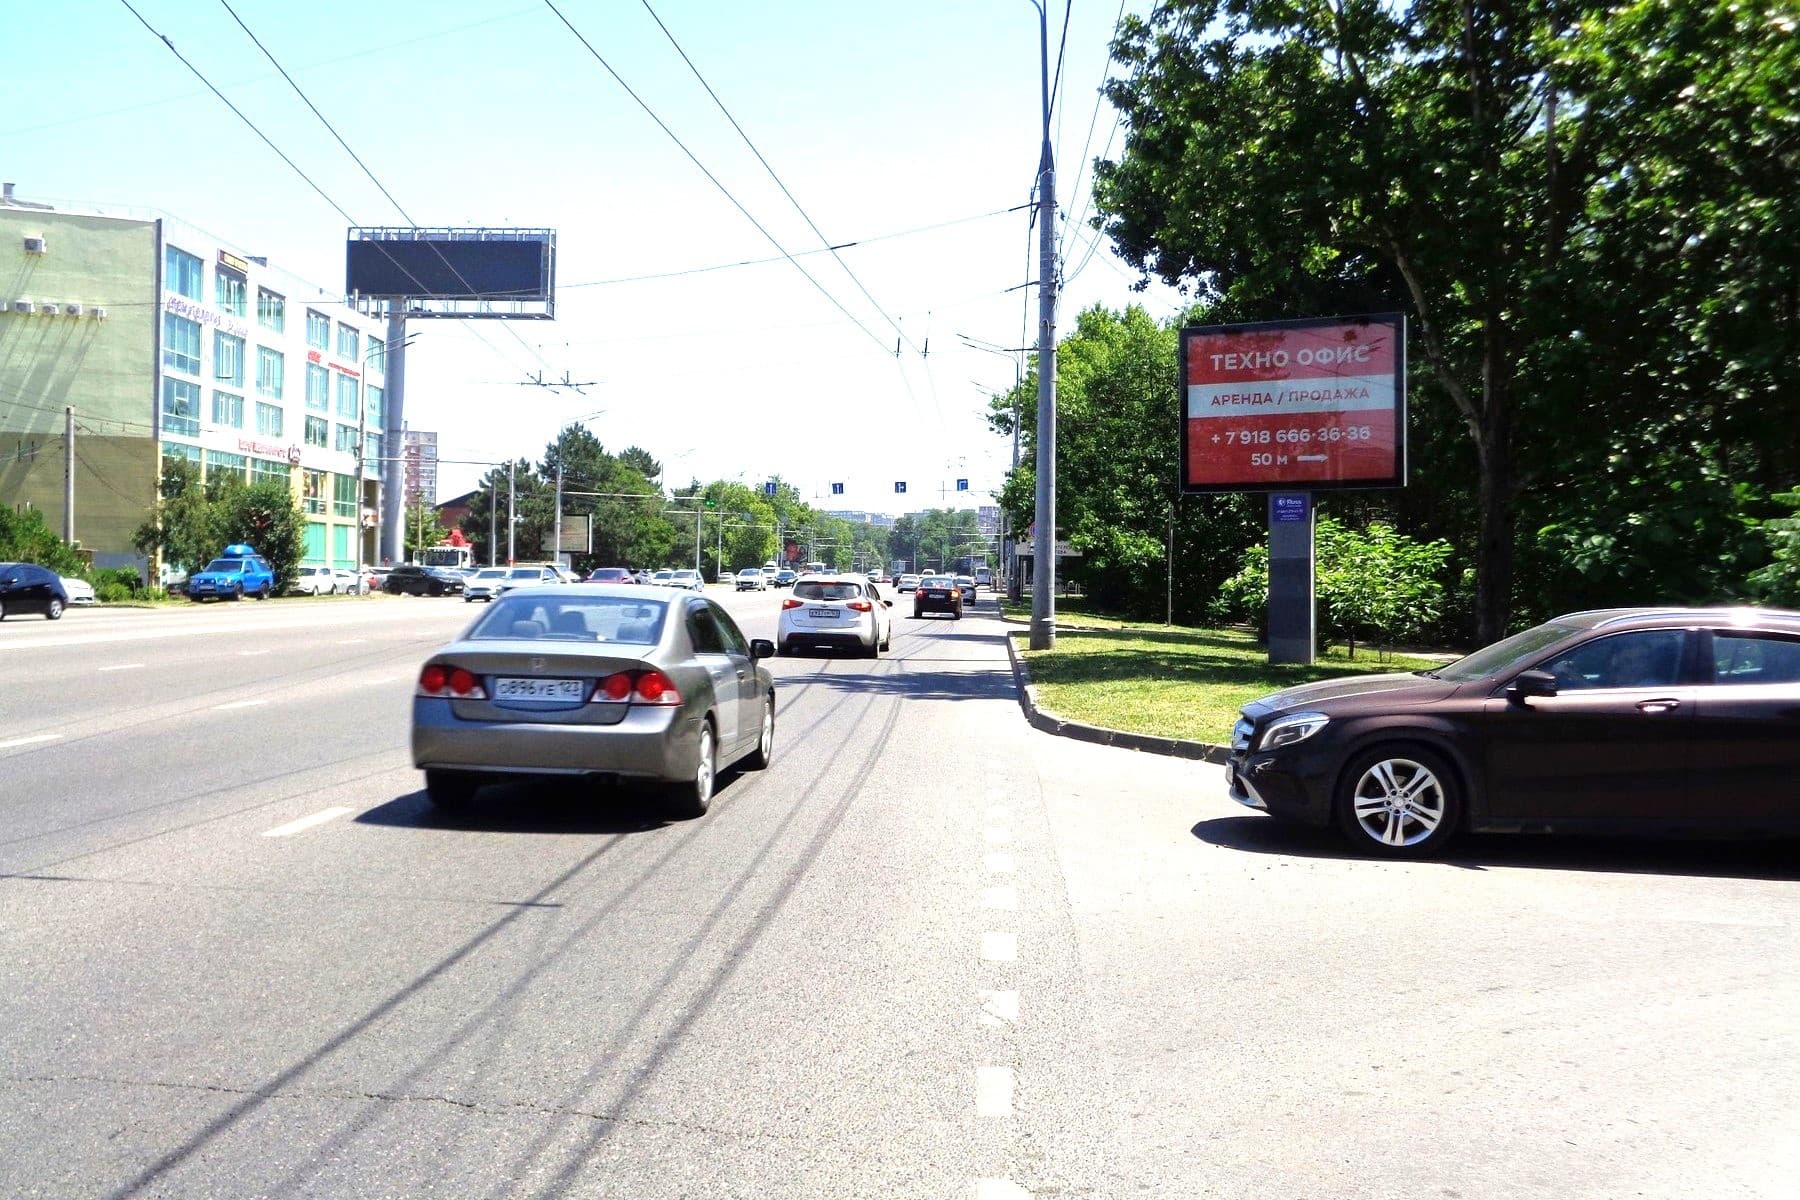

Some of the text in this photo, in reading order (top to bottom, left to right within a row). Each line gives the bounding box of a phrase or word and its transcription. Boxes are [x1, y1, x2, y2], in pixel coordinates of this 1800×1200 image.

[1210, 345, 1371, 371] ТЕХНО ОФИС
[1211, 392, 1273, 406] АРЕНДА
[1289, 386, 1370, 402] ПРОДАЖА
[1240, 430, 1270, 445] 918
[1251, 452, 1272, 466] 50
